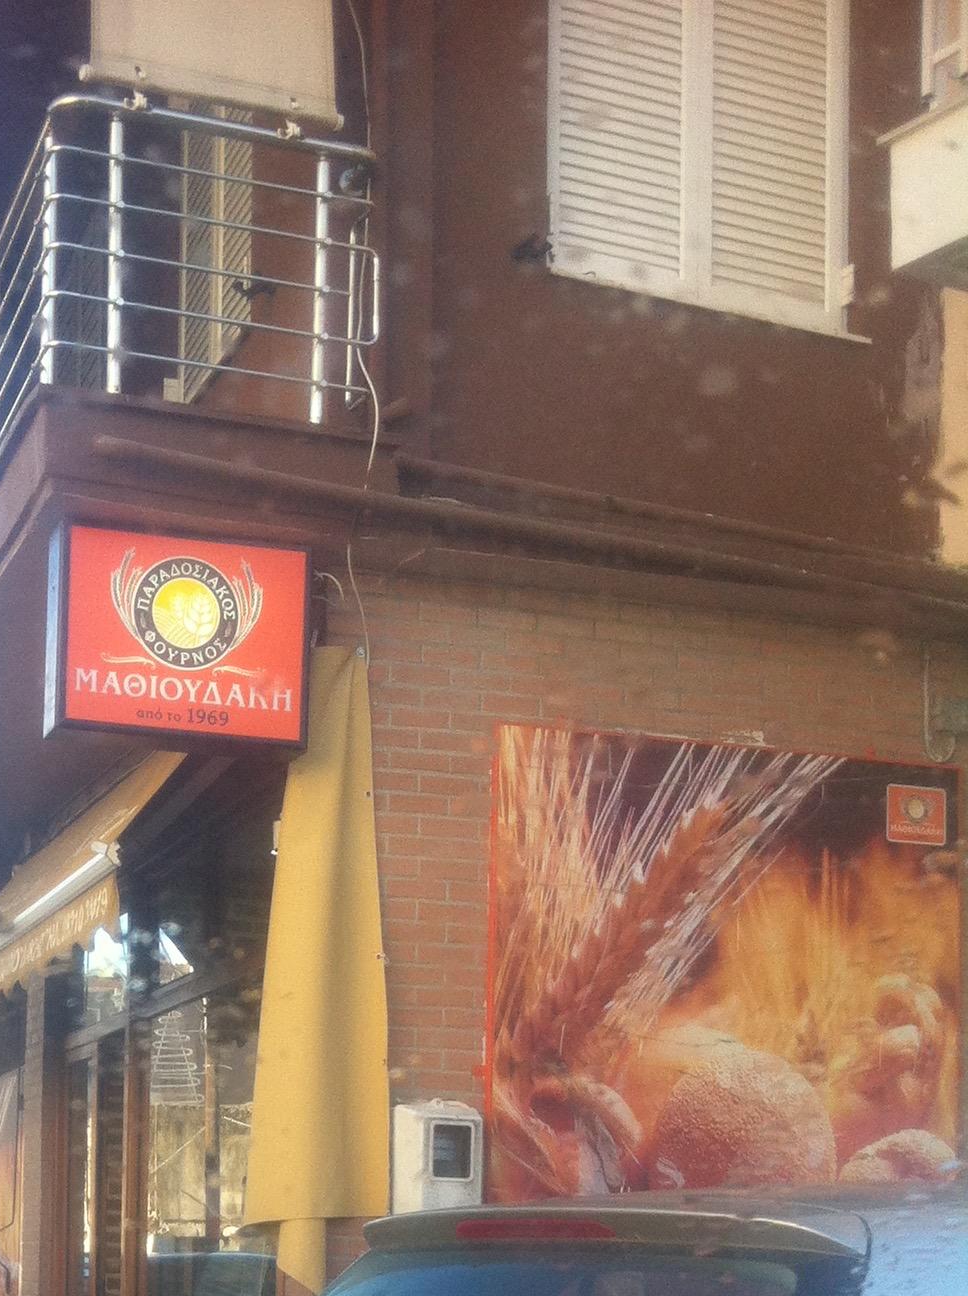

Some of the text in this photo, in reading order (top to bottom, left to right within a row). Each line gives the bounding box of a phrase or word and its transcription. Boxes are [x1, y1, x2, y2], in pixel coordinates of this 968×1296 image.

[136, 562, 236, 621] ΠΑΡΑΔΟΣΙΑΚΟΣ
[144, 629, 228, 666] ΦΟΥΡΝΟΣ
[75, 668, 294, 712] ΜΑΘΙΟΥΔΑΚΗ
[136, 708, 229, 726] από το 1969
